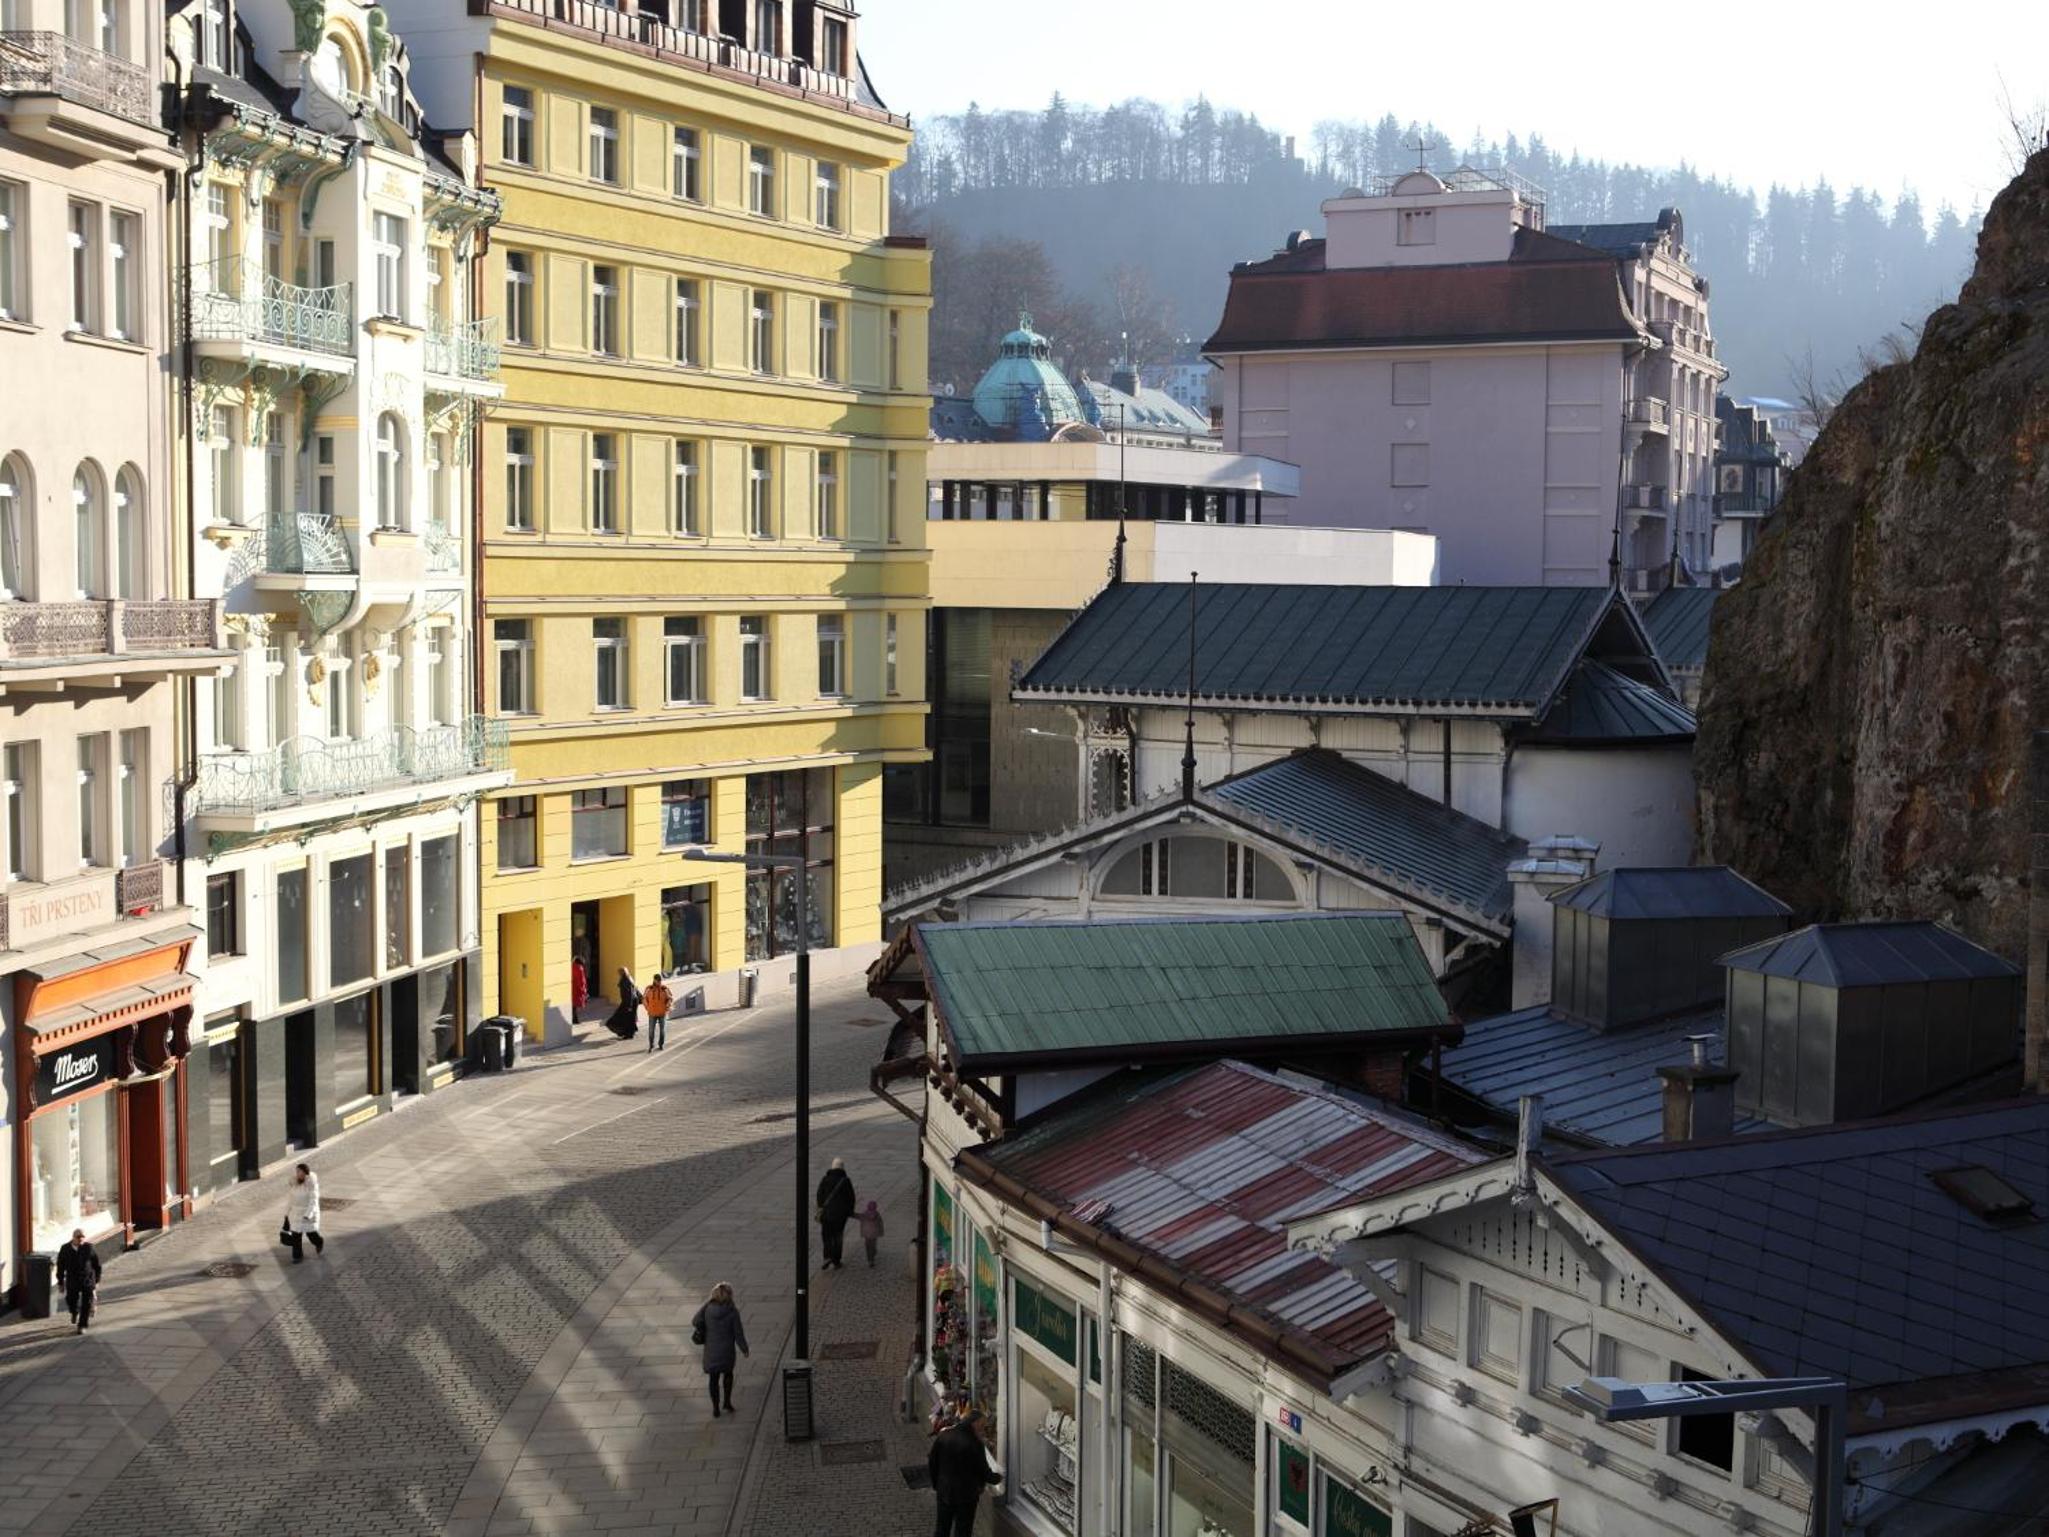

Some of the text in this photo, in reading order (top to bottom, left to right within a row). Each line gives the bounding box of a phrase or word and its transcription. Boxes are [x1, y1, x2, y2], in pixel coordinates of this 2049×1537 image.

[20, 890, 102, 929] TŘI PRSTENY
[53, 1053, 99, 1087] Moser
